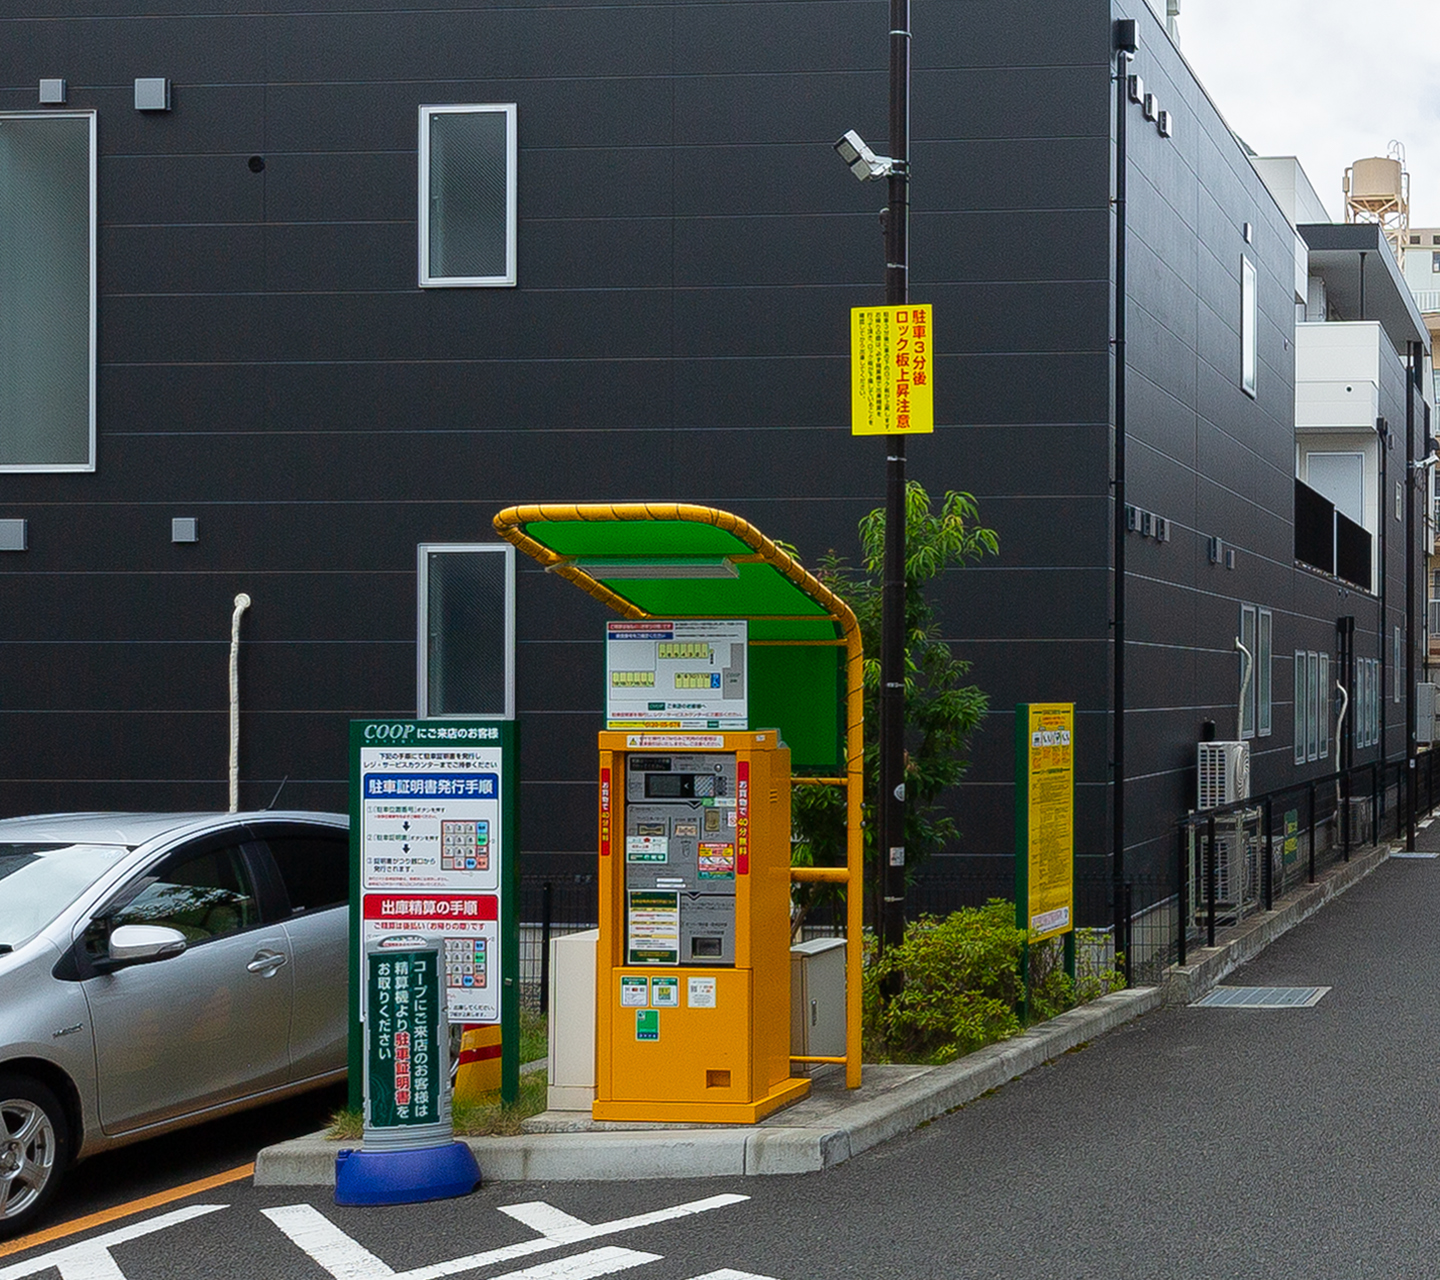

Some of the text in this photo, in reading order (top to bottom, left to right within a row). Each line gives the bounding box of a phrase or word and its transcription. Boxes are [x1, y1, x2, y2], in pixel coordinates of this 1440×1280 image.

[896, 311, 910, 429] ロック板上昇注意
[912, 309, 926, 386] 駐車3分後
[364, 724, 416, 740] COOP
[368, 779, 493, 795] 駐車証明書発行手順
[381, 900, 478, 916] 出庫精算の手順
[378, 962, 391, 1060] お取りください
[394, 960, 411, 1119] 精算機より駐車証明書を
[414, 960, 429, 1117] コープにご来店のお客様は
